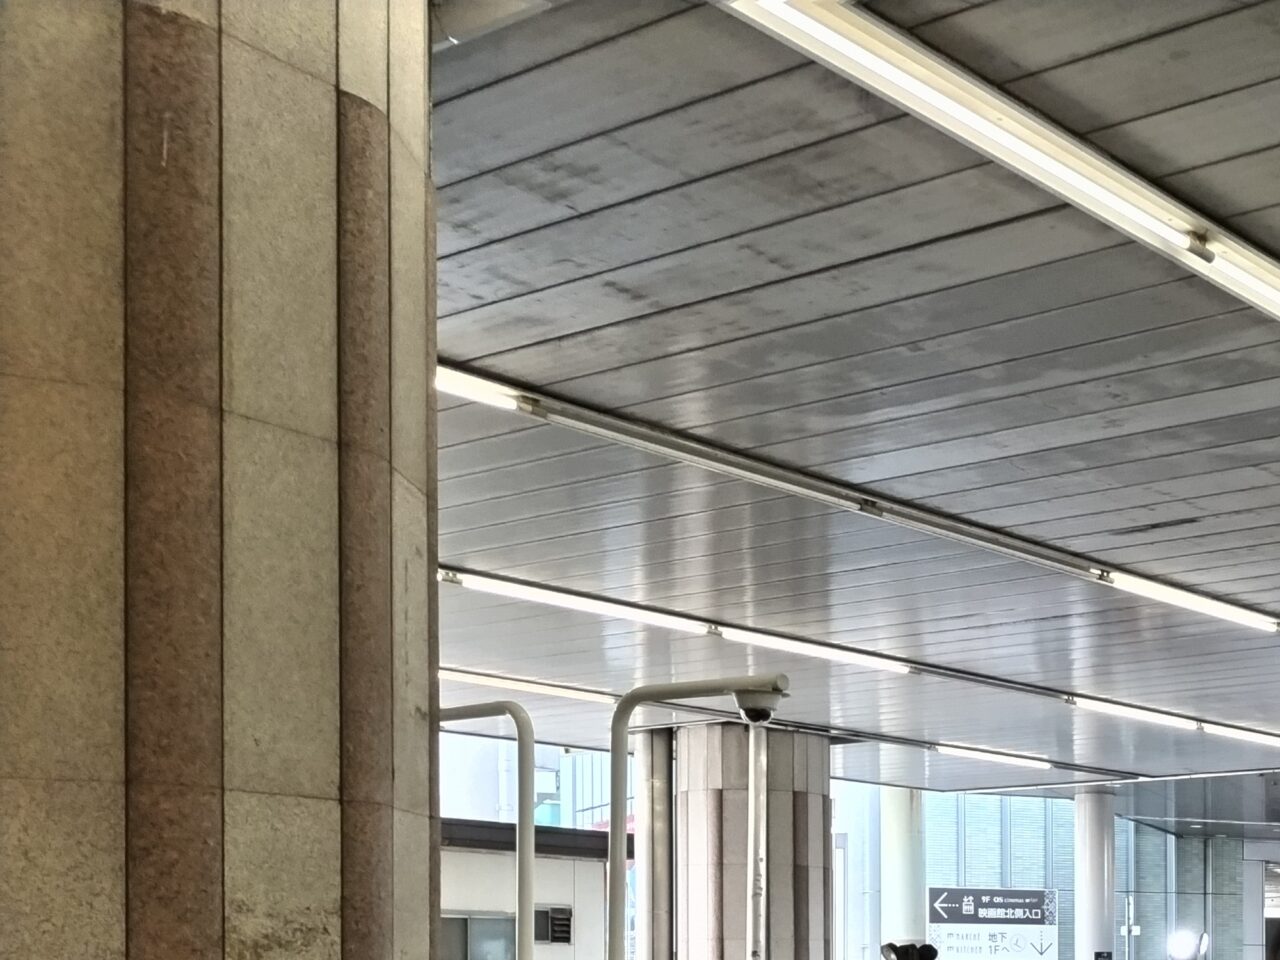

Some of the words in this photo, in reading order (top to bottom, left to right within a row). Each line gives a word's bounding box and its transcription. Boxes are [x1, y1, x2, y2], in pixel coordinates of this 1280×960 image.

[978, 907, 1041, 918] 映画館北側入口
[988, 932, 1007, 943] 地下
